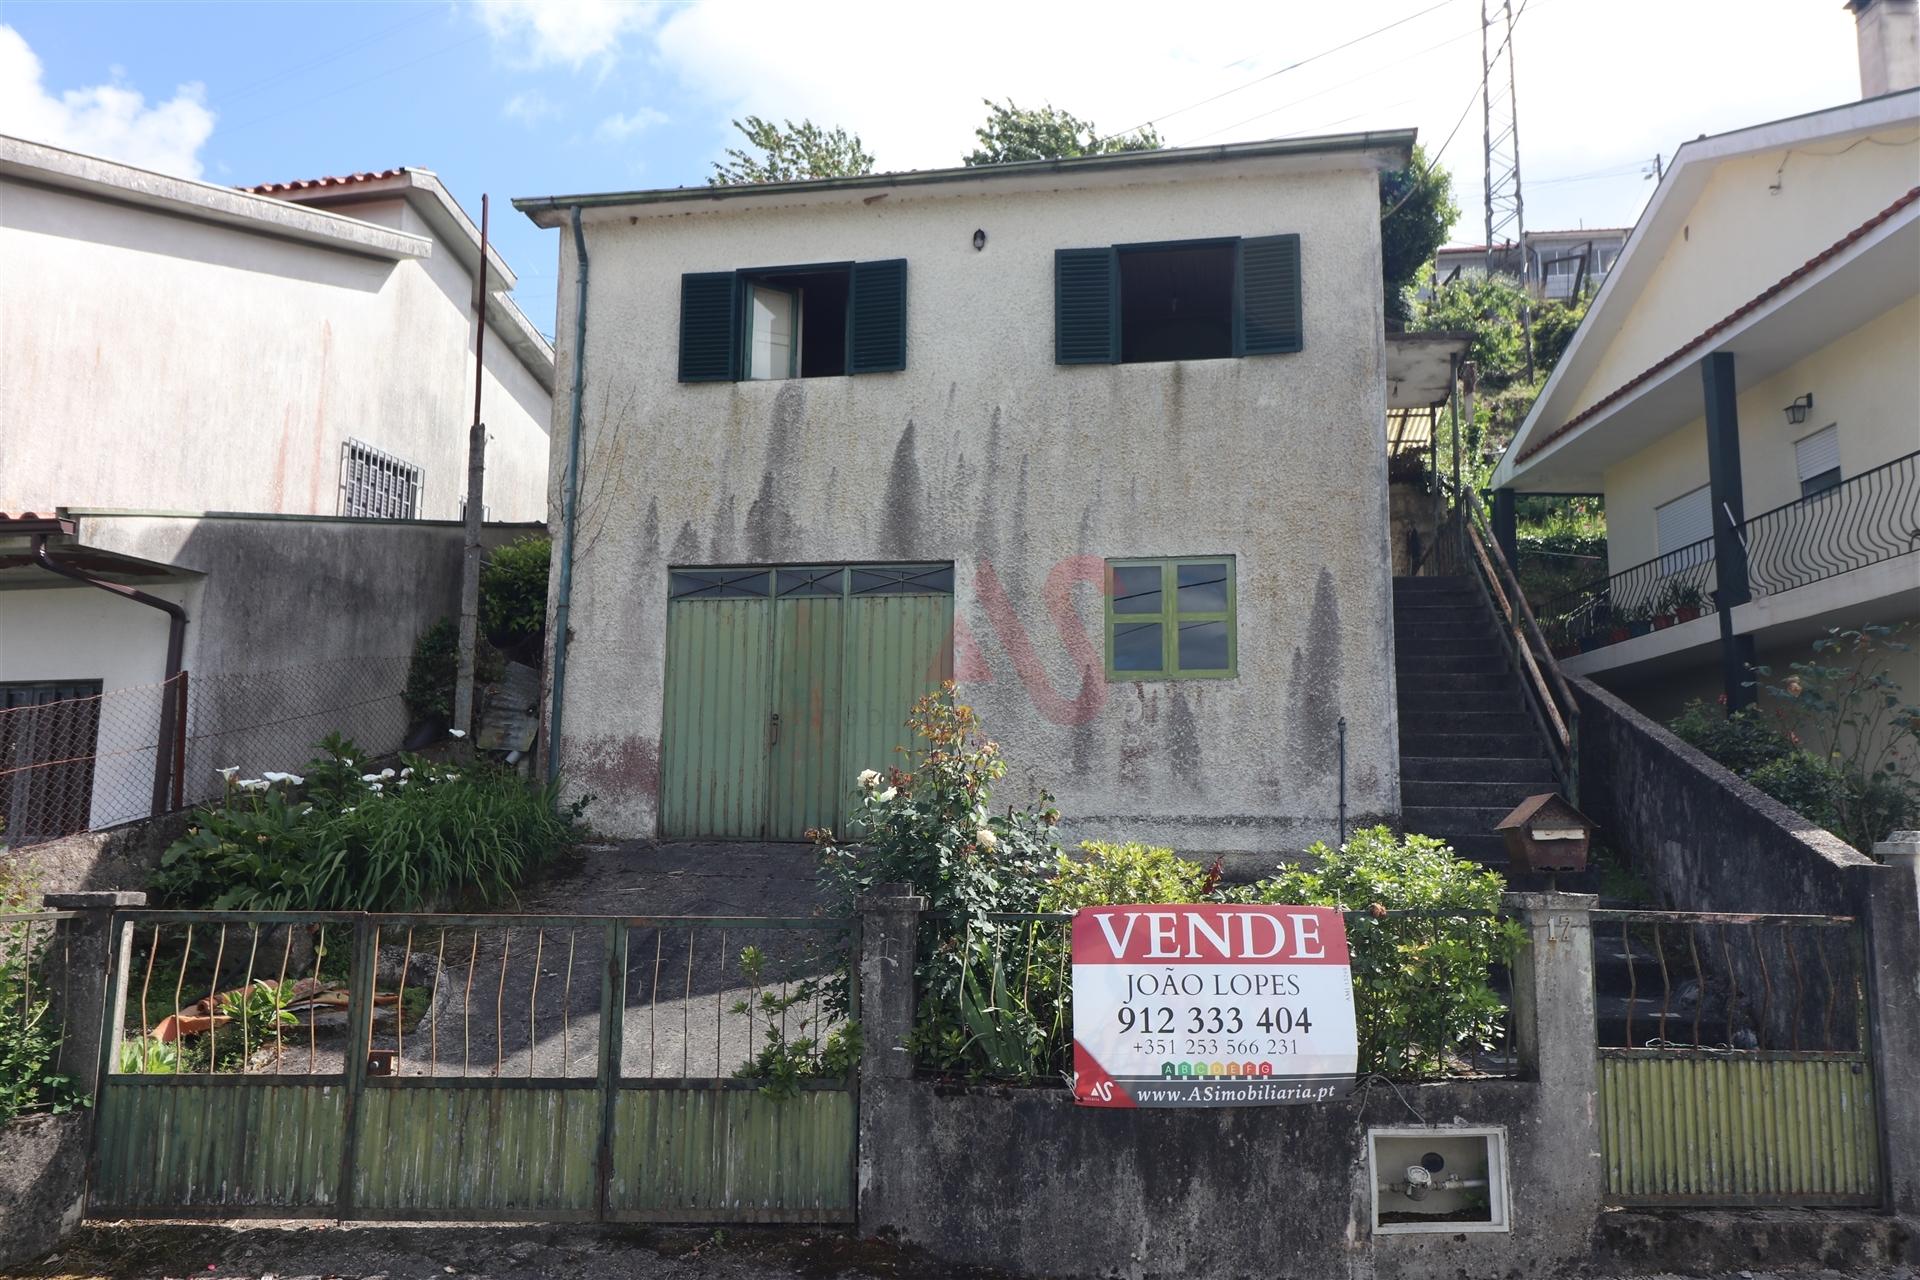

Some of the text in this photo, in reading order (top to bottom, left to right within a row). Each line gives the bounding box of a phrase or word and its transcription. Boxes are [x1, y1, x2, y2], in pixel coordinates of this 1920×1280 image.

[1093, 912, 1325, 959] VENDE
[1123, 968, 1300, 1004] JOÃO LOPES
[1117, 1007, 1312, 1034] 912 333 404
[1133, 1039, 1298, 1055] +351 253 566 231
[1137, 1084, 1335, 1102] www.ASimobiliaria.pt
